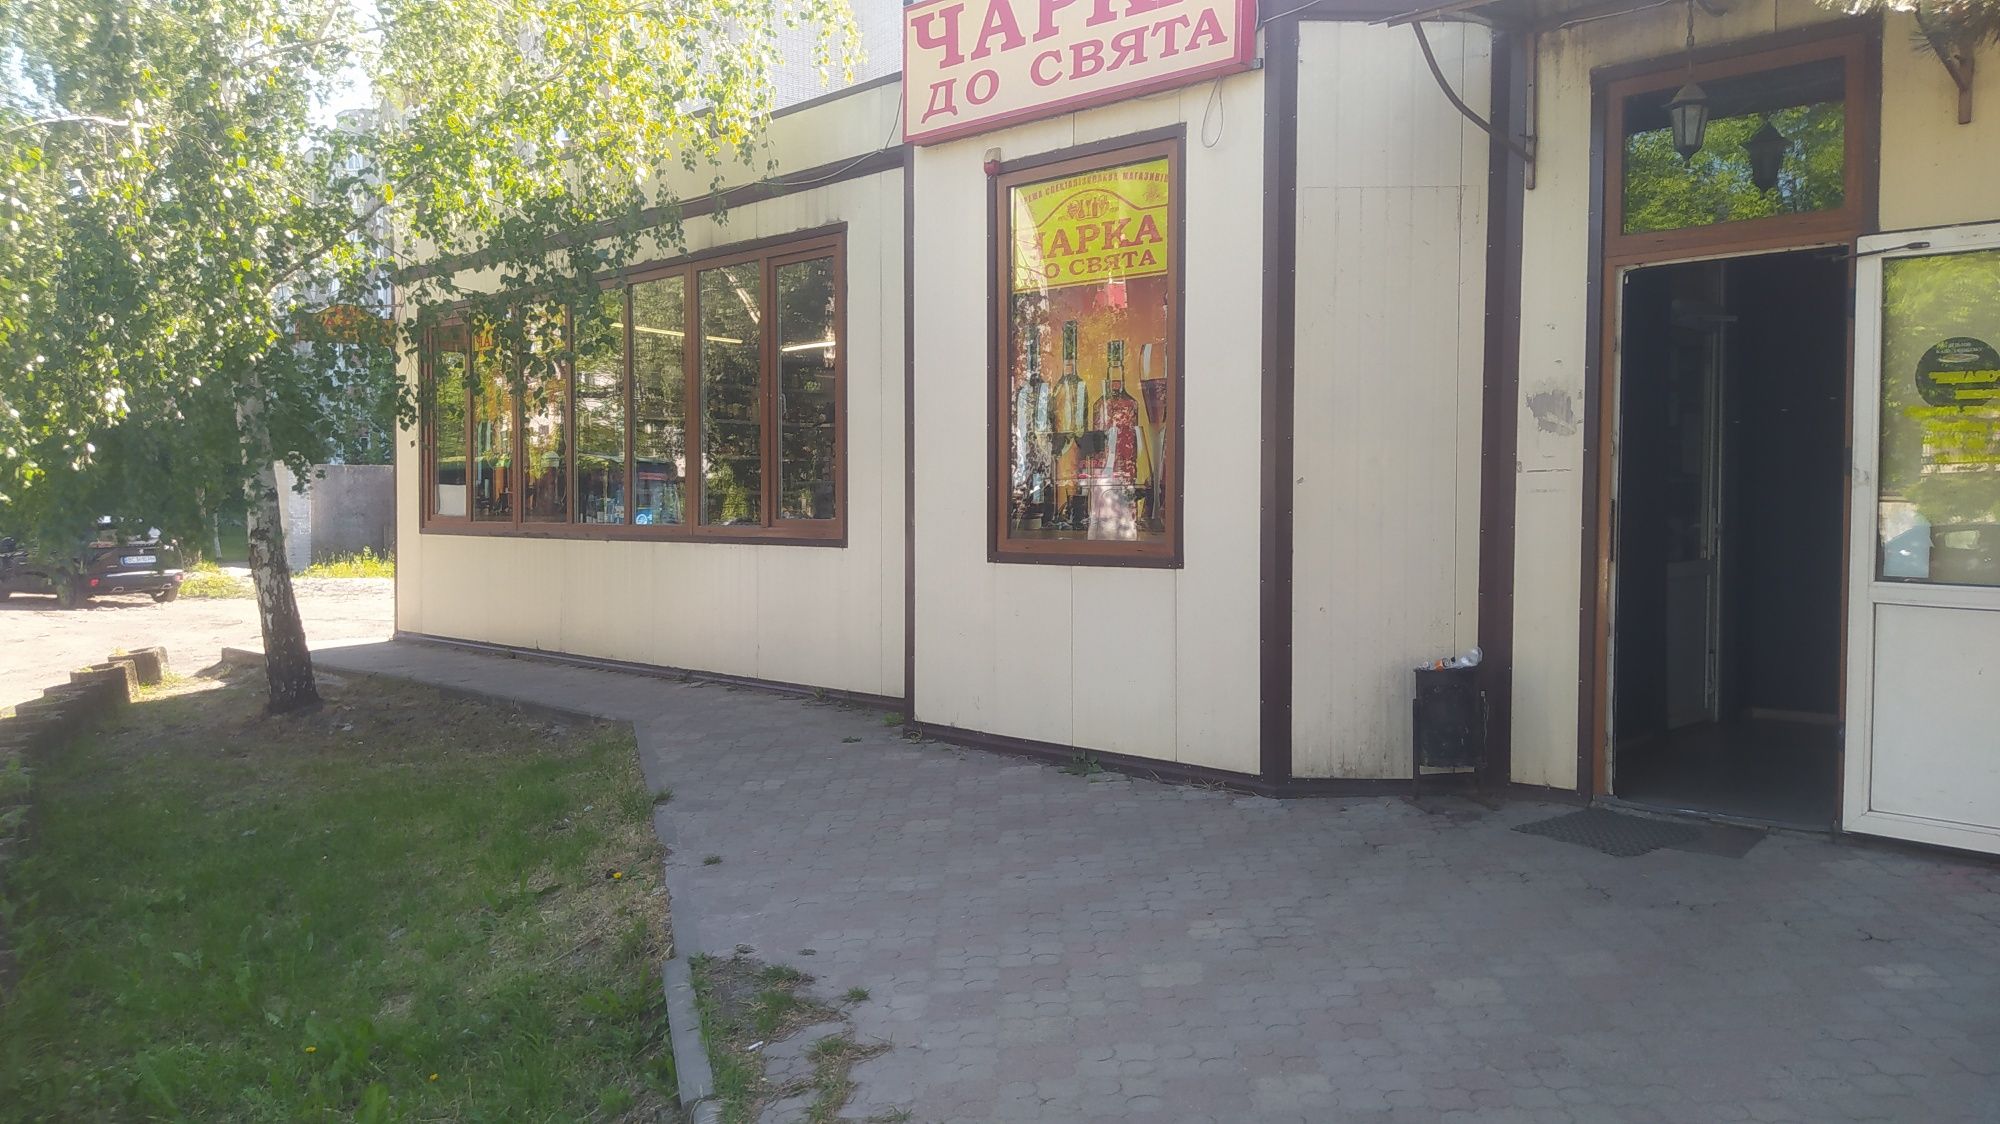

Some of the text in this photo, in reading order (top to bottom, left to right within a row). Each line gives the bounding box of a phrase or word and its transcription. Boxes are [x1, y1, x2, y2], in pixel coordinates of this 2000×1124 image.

[921, 8, 1228, 124] ДО СВЯТА
[1069, 250, 1157, 275] СВЯТА
